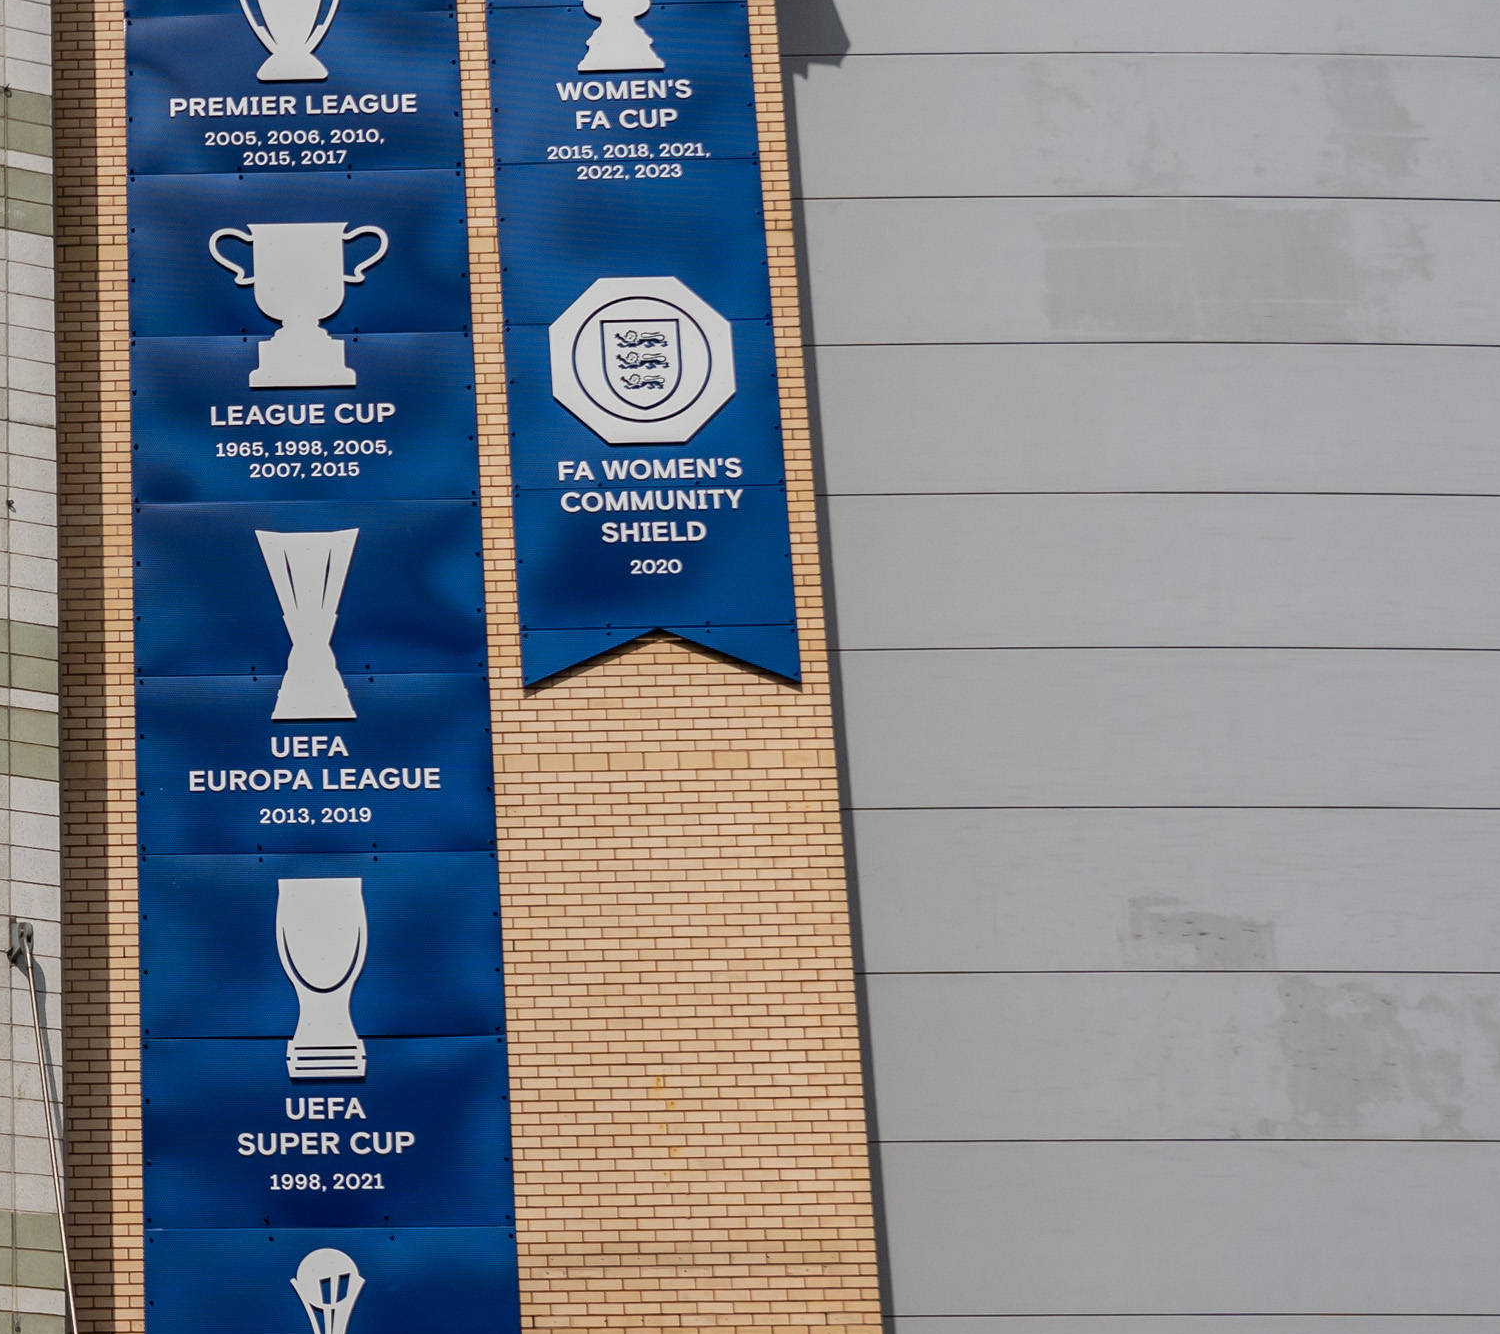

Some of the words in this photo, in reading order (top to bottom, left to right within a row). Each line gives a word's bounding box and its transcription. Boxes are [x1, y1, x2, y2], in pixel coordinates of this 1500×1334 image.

[556, 79, 692, 100] WOMEN'S
[170, 96, 296, 117] PREMIER
[306, 94, 417, 114] LEAGUE
[576, 110, 611, 129] FA
[619, 109, 677, 128] CUP
[205, 131, 261, 146] 2005,
[268, 130, 324, 144] 2006,
[331, 129, 384, 144] 2010,
[243, 151, 295, 166] 2015,
[301, 150, 346, 164] 2017
[547, 145, 598, 160] 2015,
[603, 144, 654, 159] 2018,
[659, 143, 710, 157] 2021,
[577, 165, 629, 180] 2022,
[635, 164, 682, 178] 2023
[211, 404, 325, 425] LEAGUE
[335, 403, 395, 423] CUP
[216, 442, 268, 457] 1965,
[275, 441, 327, 456] 1998,
[334, 440, 392, 455] 2005,
[250, 463, 305, 478] 2007,
[311, 462, 359, 476] 2015
[558, 460, 595, 480] FA
[601, 458, 742, 479] WOMEN'S
[561, 489, 743, 512] COMMUNITY
[602, 521, 706, 542] SHIELD
[630, 559, 682, 574] 2020
[271, 736, 348, 757] UEFA
[190, 769, 313, 791] EUROPA
[323, 768, 440, 789] LEAGUE
[260, 808, 315, 824] 2013,
[322, 808, 371, 823] 2019
[286, 1098, 366, 1120] UEFA
[238, 1133, 339, 1155] SUPER
[350, 1132, 414, 1154] CUP
[271, 1174, 326, 1191] 1998,
[333, 1173, 384, 1189] 2021
